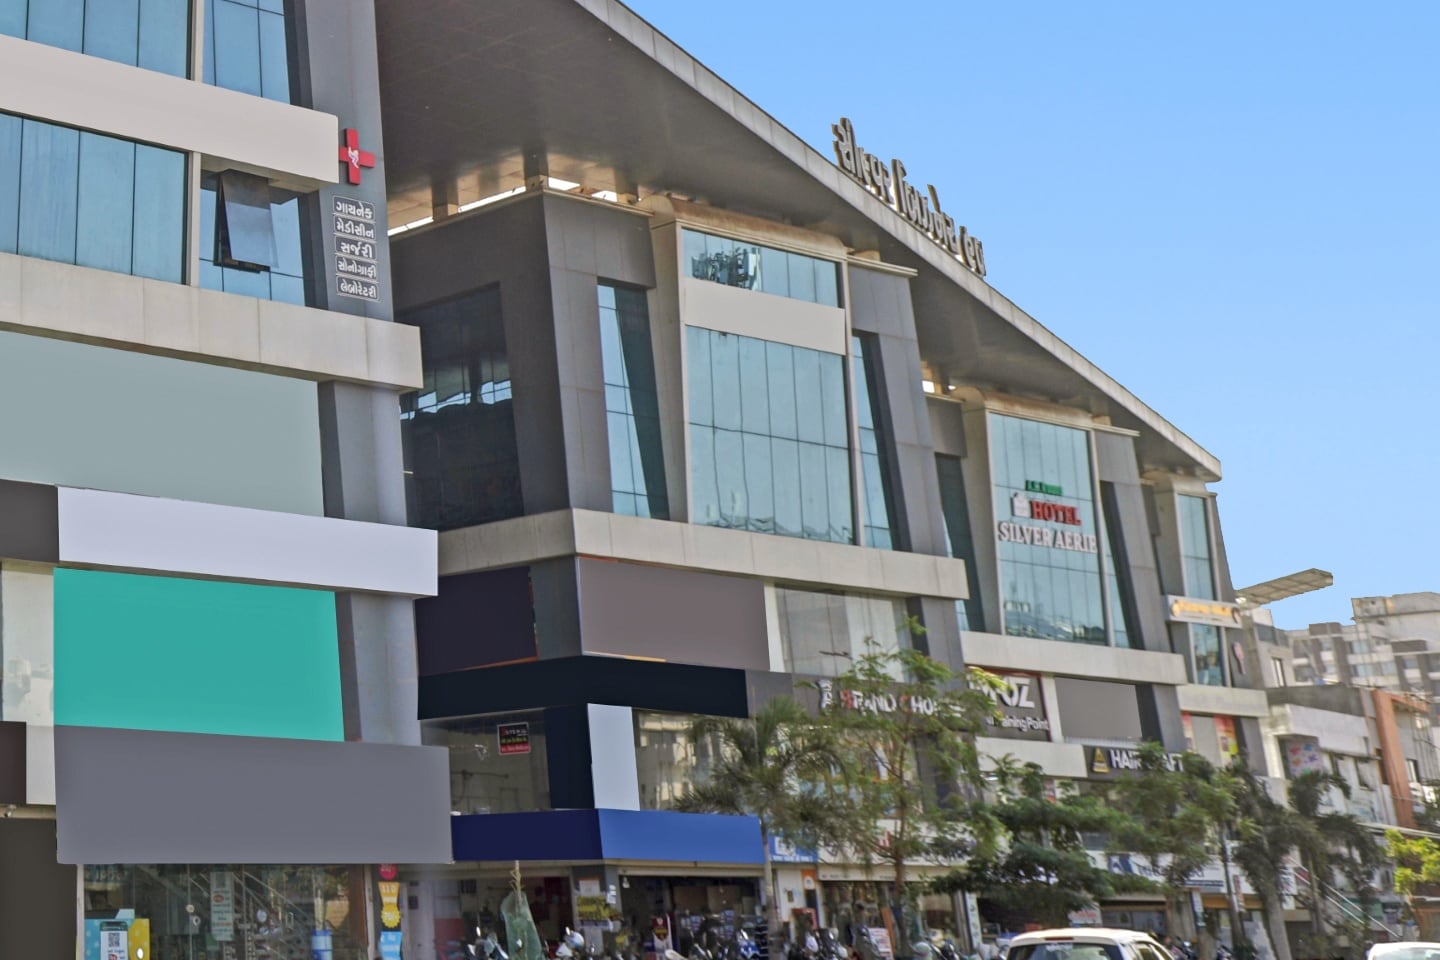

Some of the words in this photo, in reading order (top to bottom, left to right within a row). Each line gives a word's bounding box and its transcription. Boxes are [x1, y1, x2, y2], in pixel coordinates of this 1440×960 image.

[335, 201, 372, 219] ગાયનેક
[337, 218, 374, 238] મેડીસીન
[341, 242, 373, 258] સર્જરી
[1030, 500, 1082, 526] HOTEL
[998, 521, 1054, 548] SILVER
[1053, 530, 1098, 554] AERIE
